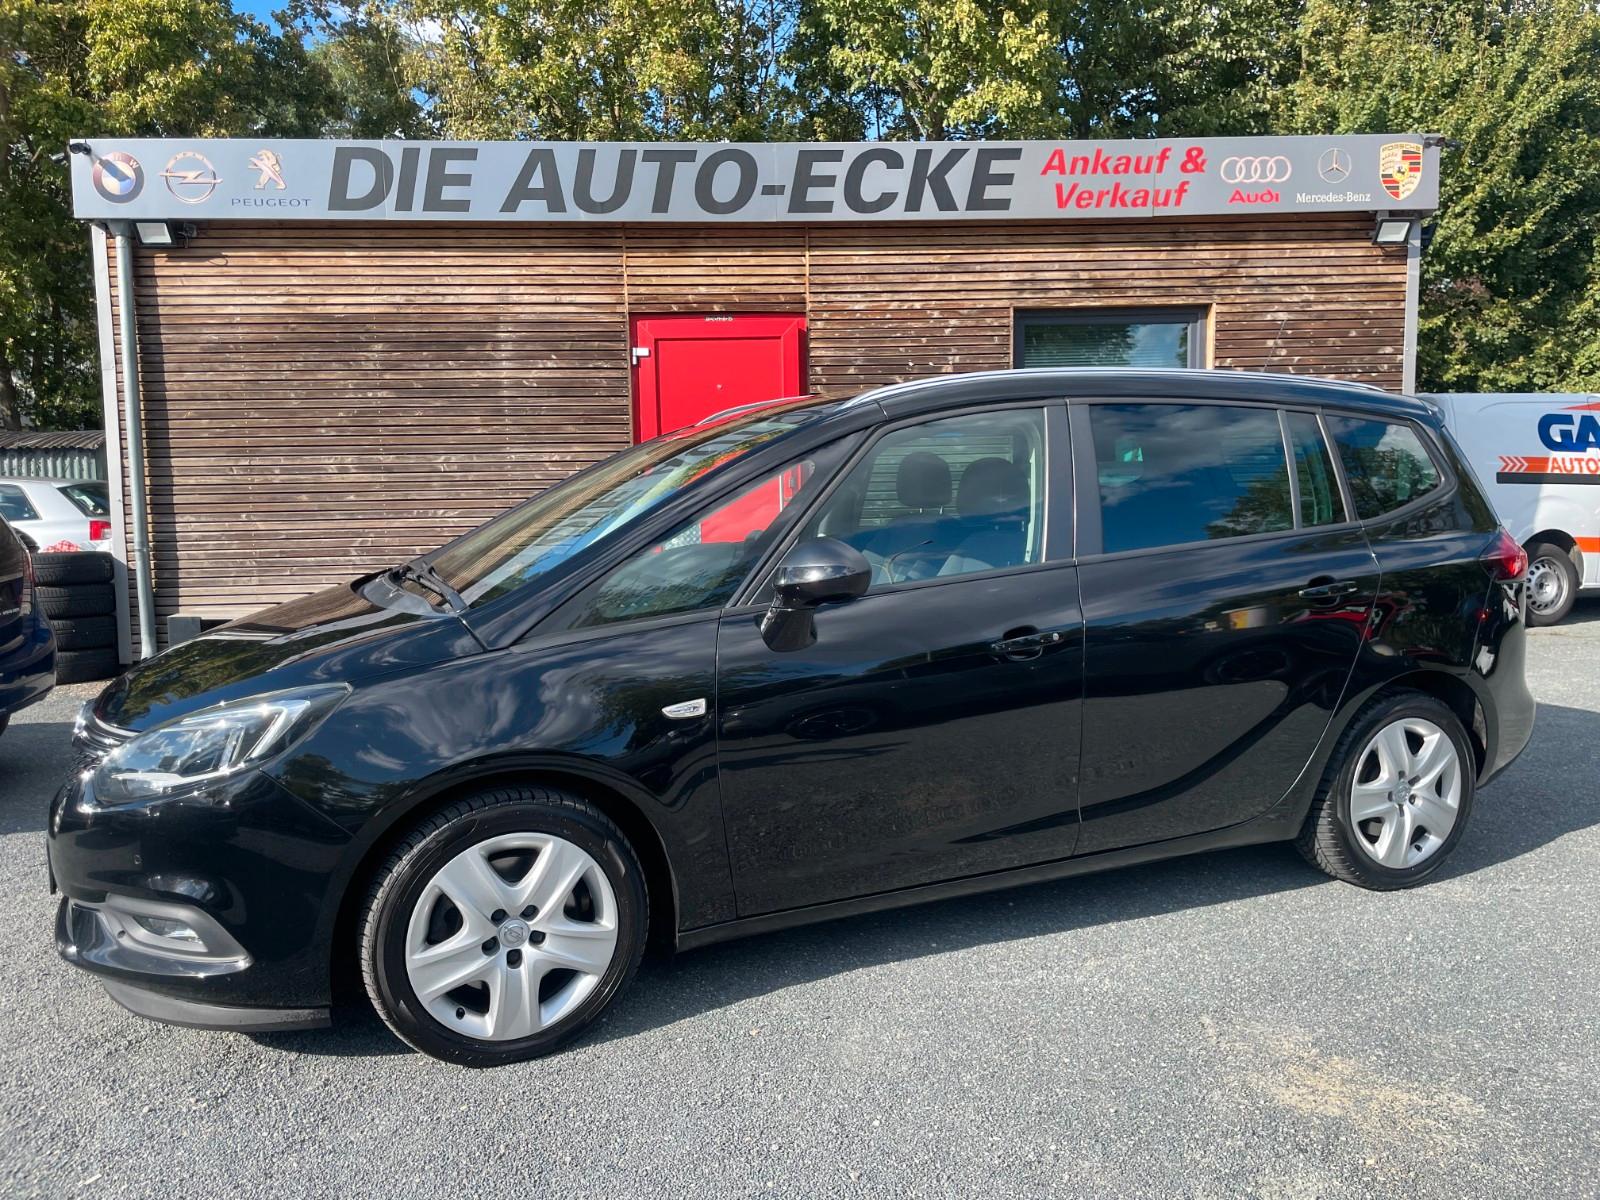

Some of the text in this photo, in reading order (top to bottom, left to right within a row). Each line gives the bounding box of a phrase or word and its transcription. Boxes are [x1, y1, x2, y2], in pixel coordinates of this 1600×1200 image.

[1039, 145, 1208, 177] Ankauf &
[328, 147, 1023, 215] DIE AUTO-ECKE
[231, 198, 312, 207] PEUGEOT
[1054, 180, 1191, 210] Verkauf
[1227, 188, 1281, 205] Audi
[1295, 191, 1372, 204] Mercedes-Benz
